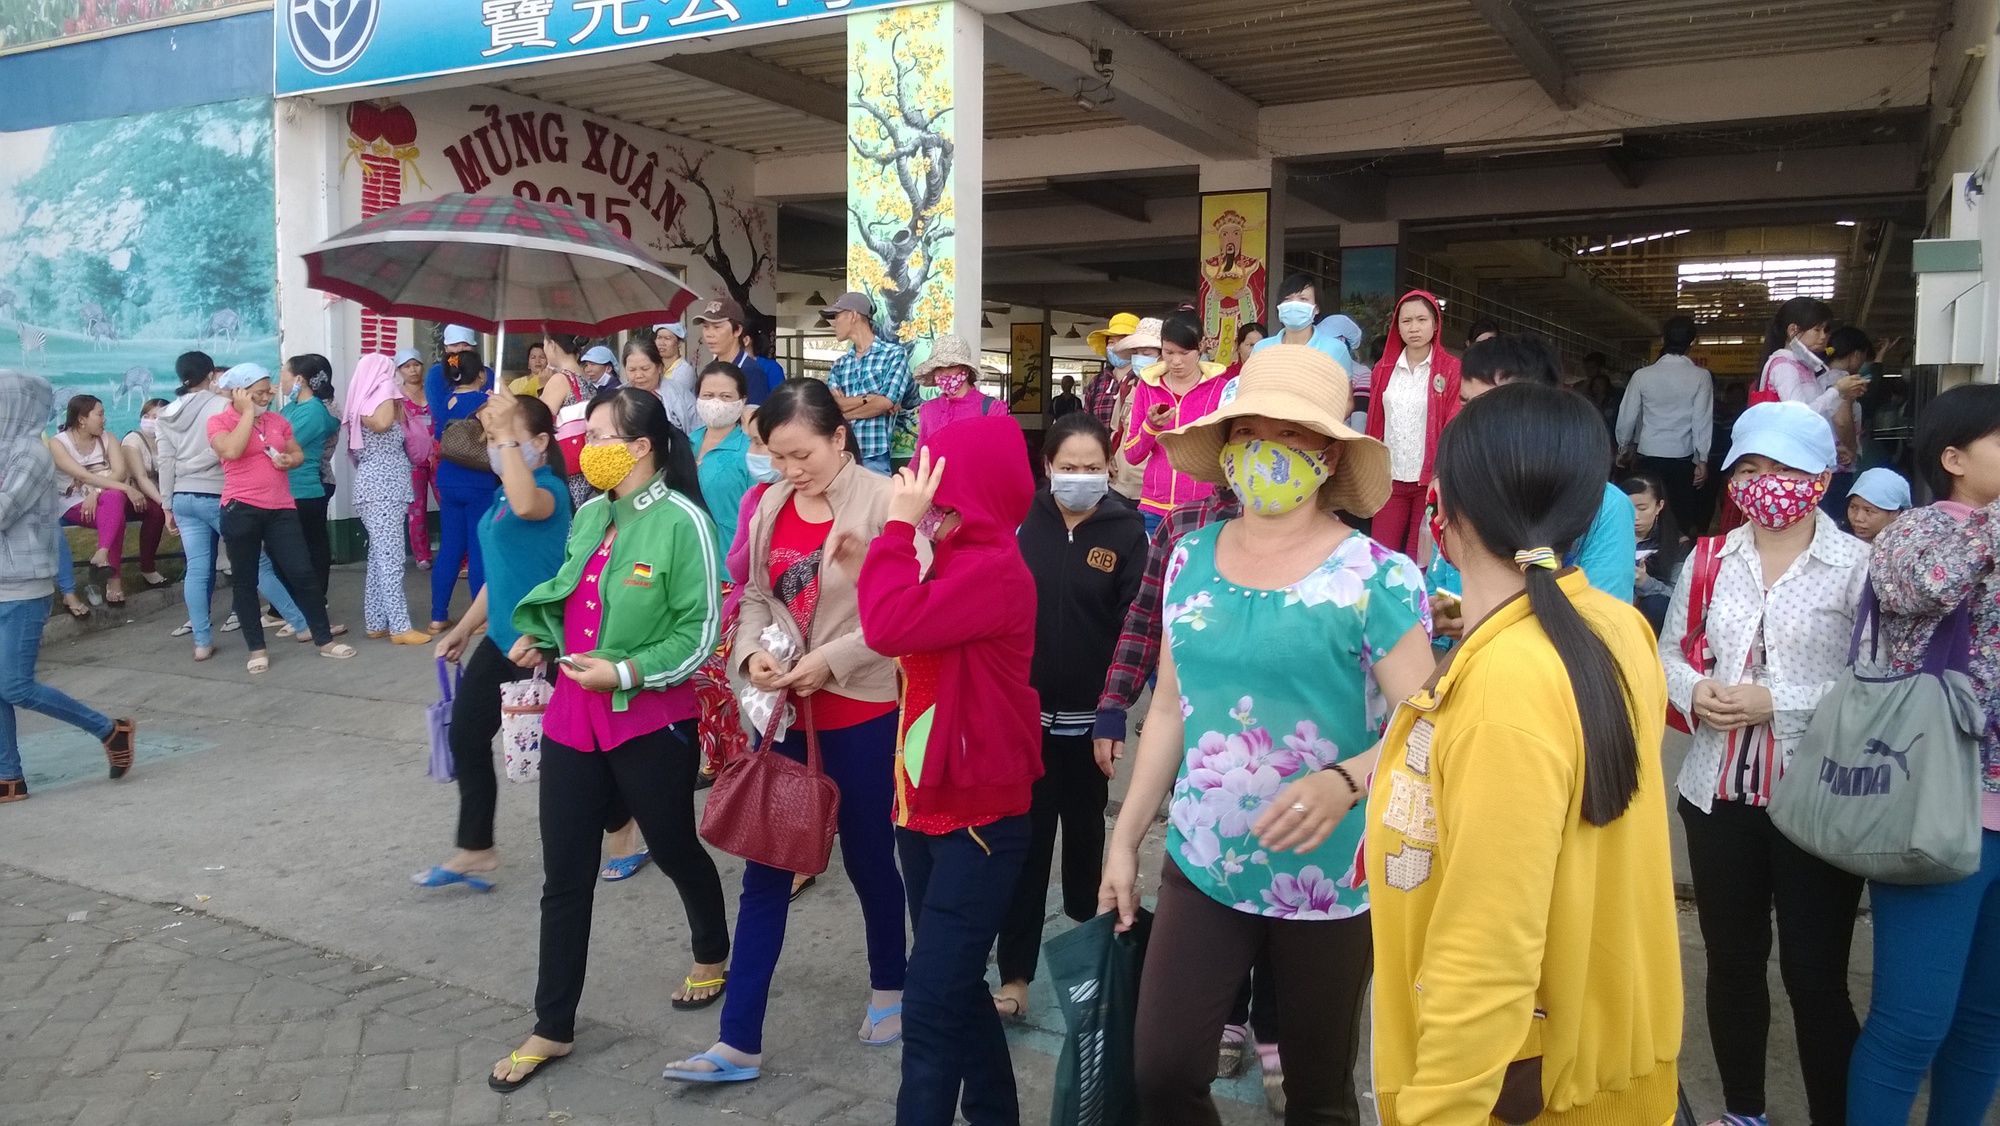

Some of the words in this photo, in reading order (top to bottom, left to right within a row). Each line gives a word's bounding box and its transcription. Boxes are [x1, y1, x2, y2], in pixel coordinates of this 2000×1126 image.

[443, 104, 568, 194] MỪNG
[582, 119, 687, 233] XUÂN
[632, 477, 669, 511] GE
[1090, 550, 1113, 568] RIB
[1818, 756, 1892, 797] PUMA
